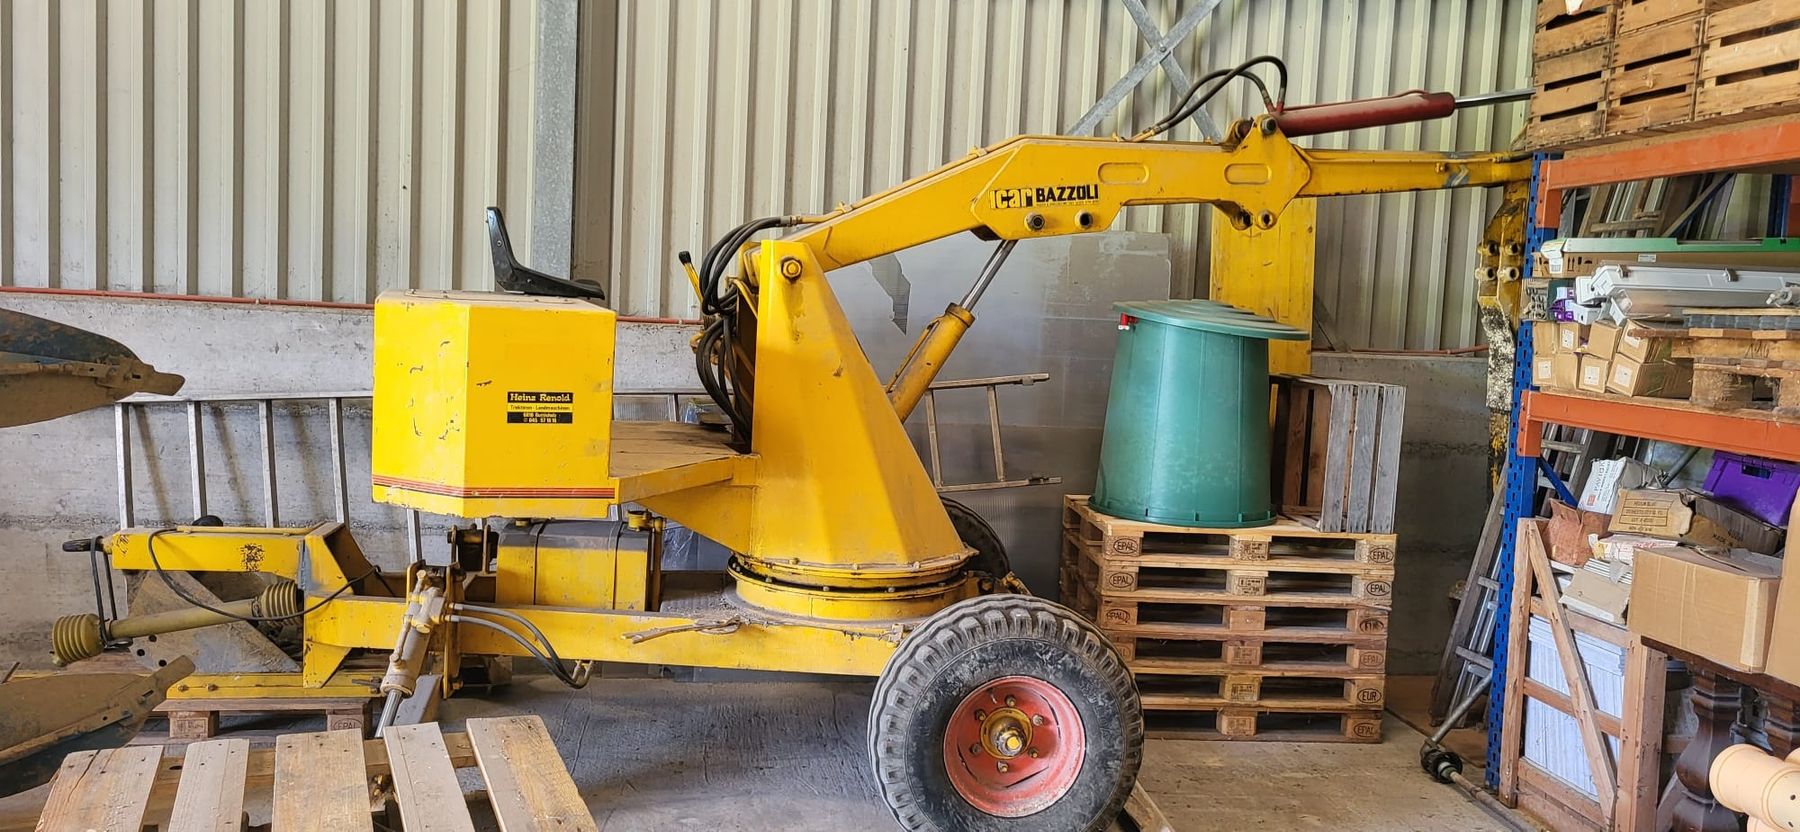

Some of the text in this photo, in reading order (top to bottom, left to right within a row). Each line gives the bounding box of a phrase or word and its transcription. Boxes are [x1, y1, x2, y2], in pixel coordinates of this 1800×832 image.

[1036, 184, 1099, 202] BAZZOLI
[510, 393, 572, 402] Heinz Renold
[1117, 540, 1135, 551] EPAL
[1372, 551, 1390, 560] EPAL
[1112, 575, 1130, 585] EPAL
[1370, 584, 1386, 593] EPAL
[1363, 654, 1380, 664] EPAL
[1362, 691, 1377, 701] EUR
[1357, 725, 1374, 734] EPAL
